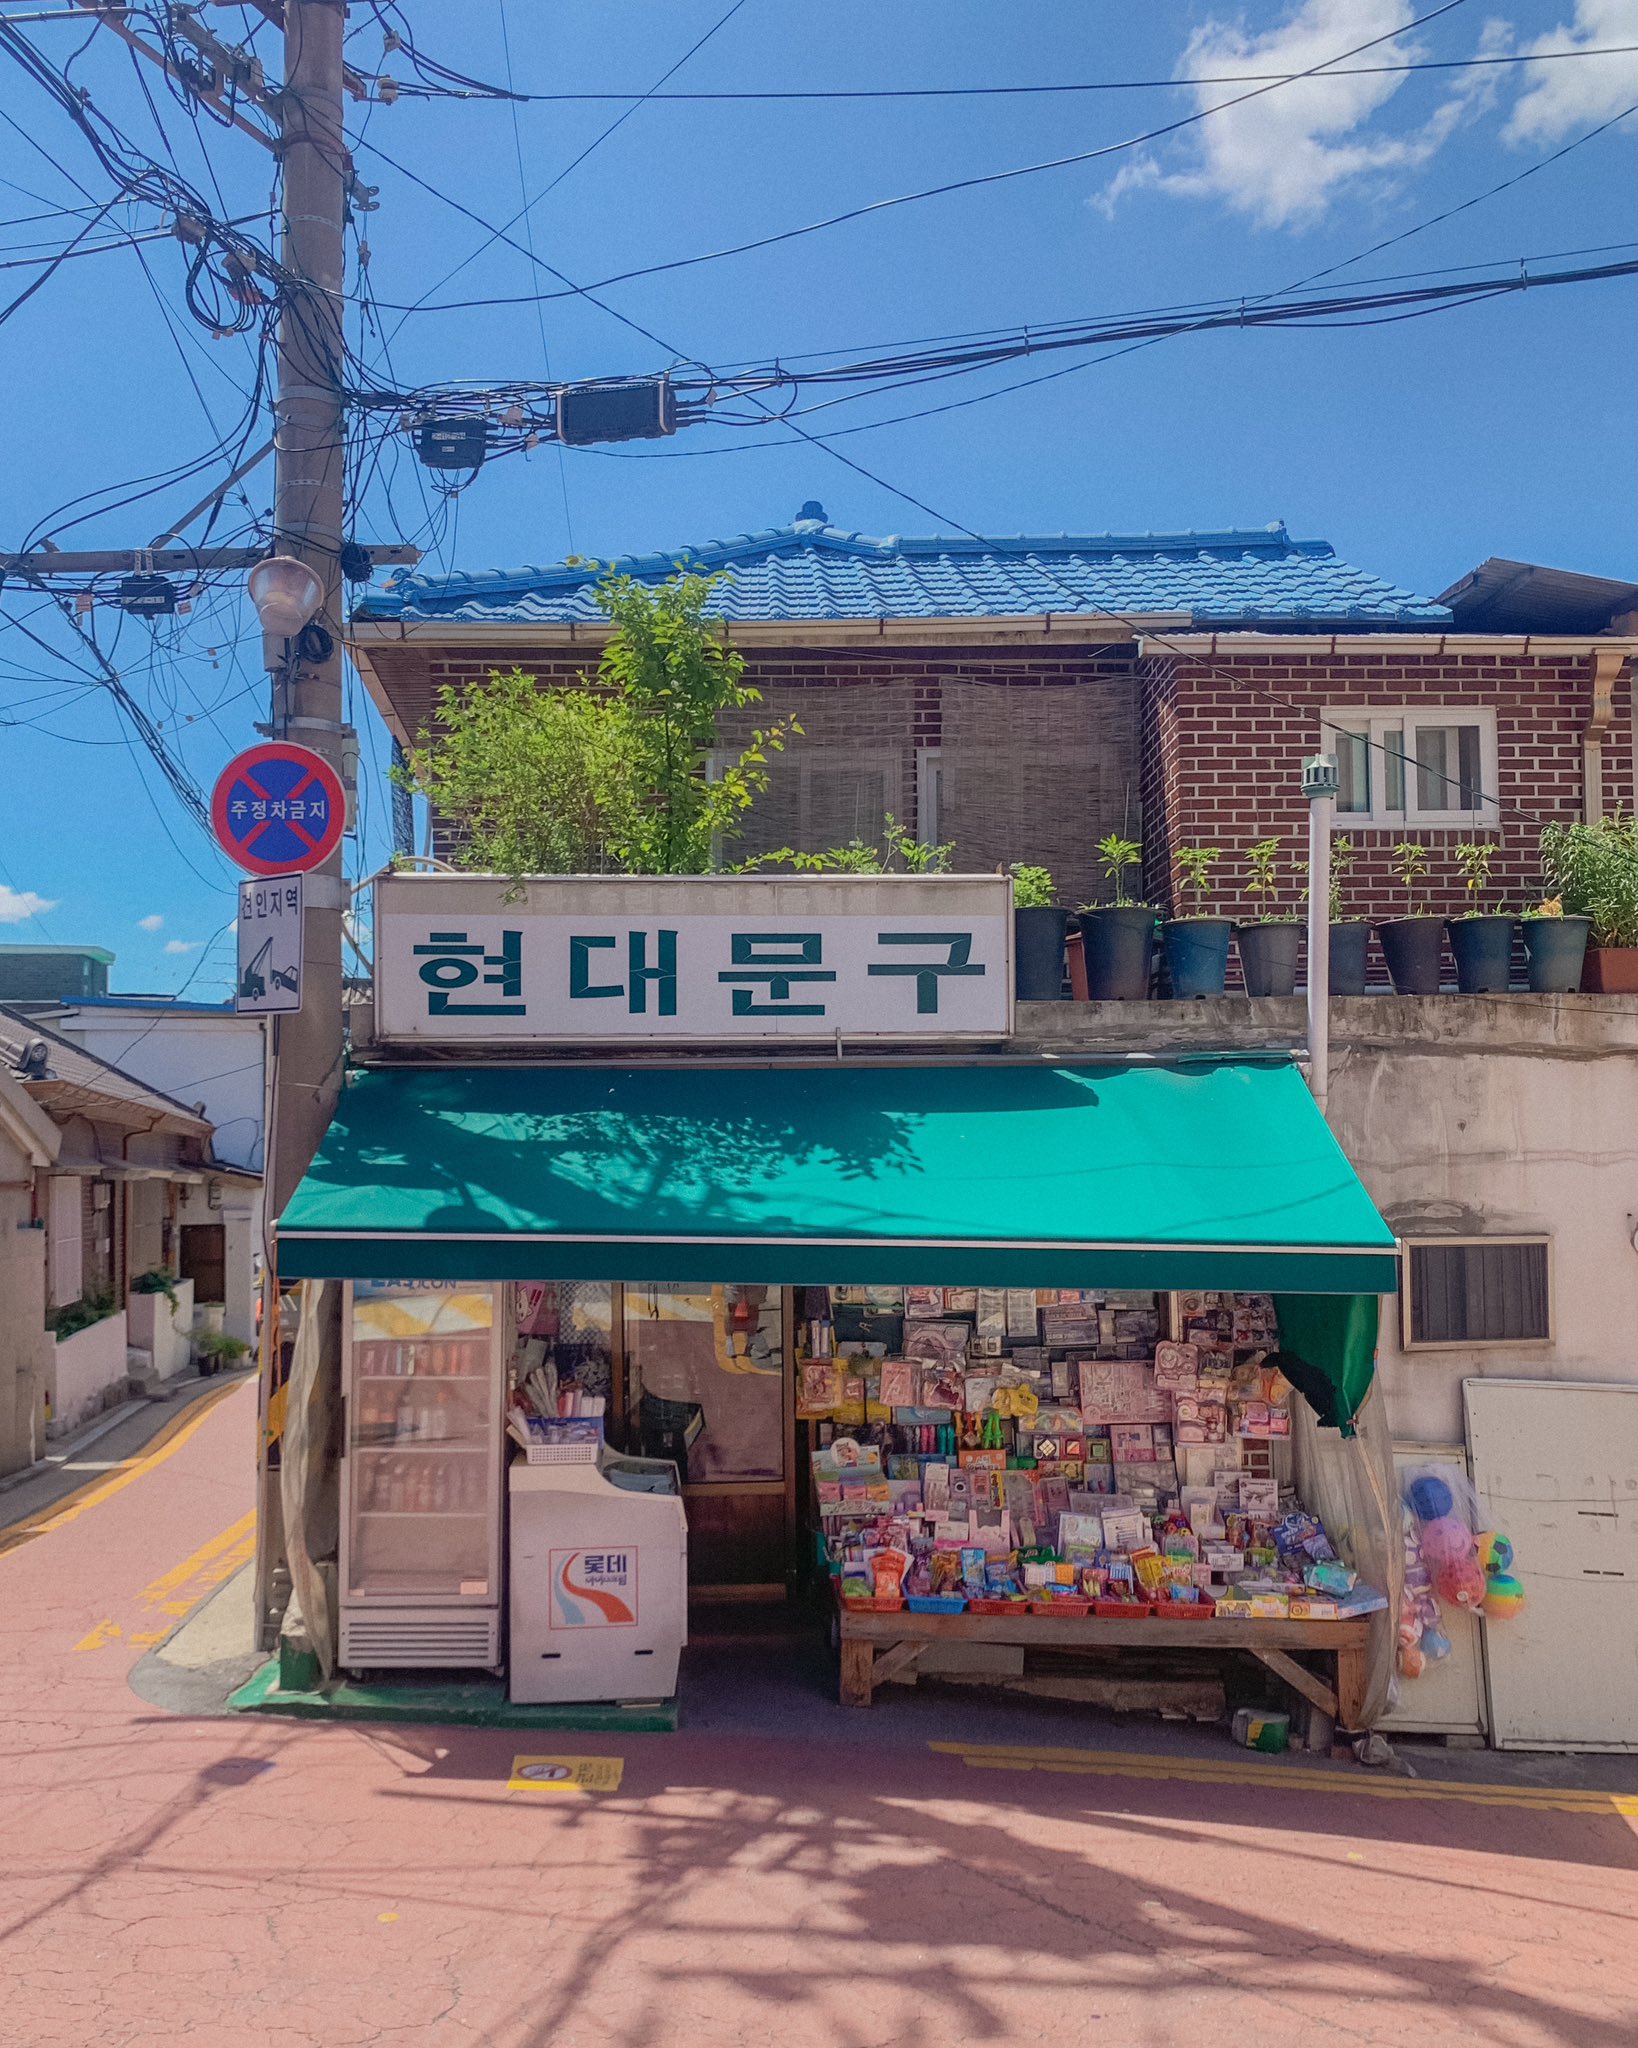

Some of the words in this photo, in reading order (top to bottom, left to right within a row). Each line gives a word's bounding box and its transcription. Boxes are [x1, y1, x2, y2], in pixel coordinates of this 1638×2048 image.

[231, 800, 326, 820] 주정차금지
[242, 886, 298, 919] 견인지역
[413, 929, 985, 1016] 현대문구
[585, 1555, 627, 1574] 롯데
